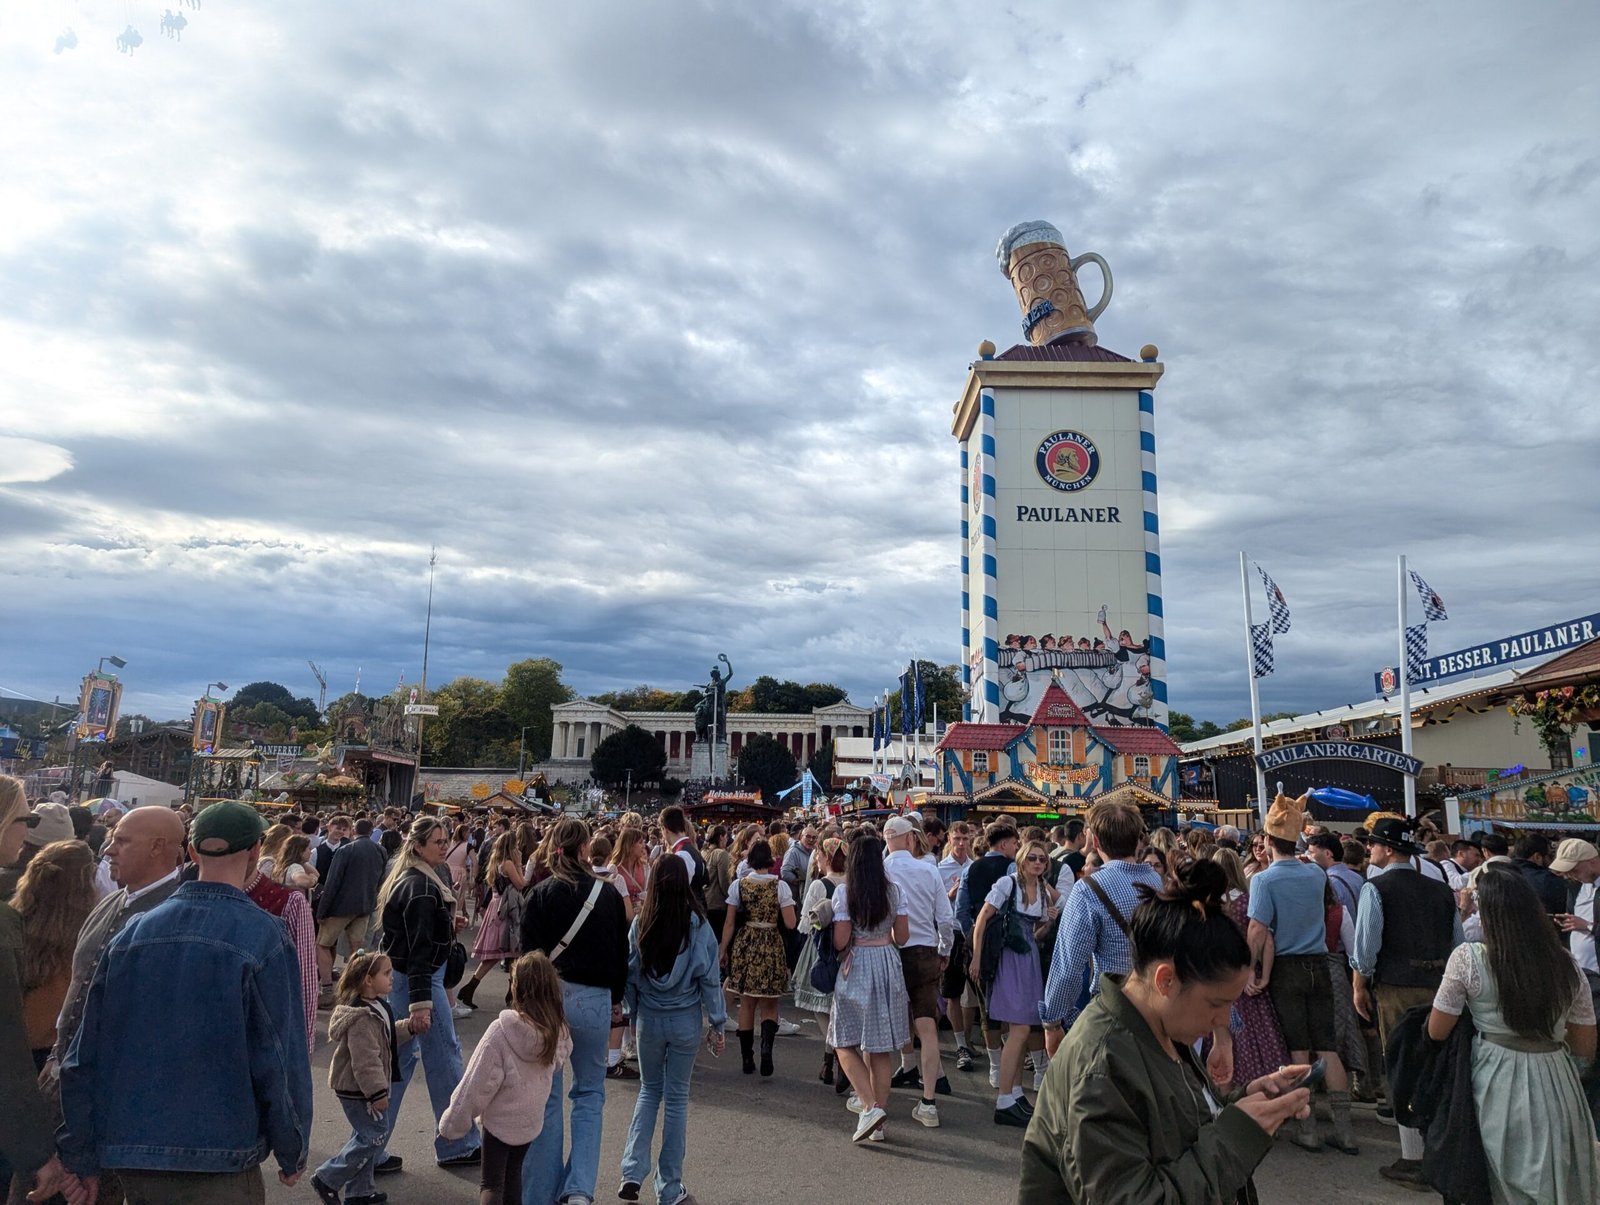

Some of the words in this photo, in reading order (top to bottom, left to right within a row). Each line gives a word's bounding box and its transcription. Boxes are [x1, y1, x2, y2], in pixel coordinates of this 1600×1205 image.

[1039, 433, 1096, 455] PAULANER
[1016, 505, 1121, 523] PAULANER
[1438, 647, 1498, 675] BESSER,
[1260, 743, 1417, 773] PAULANERGARTEN
